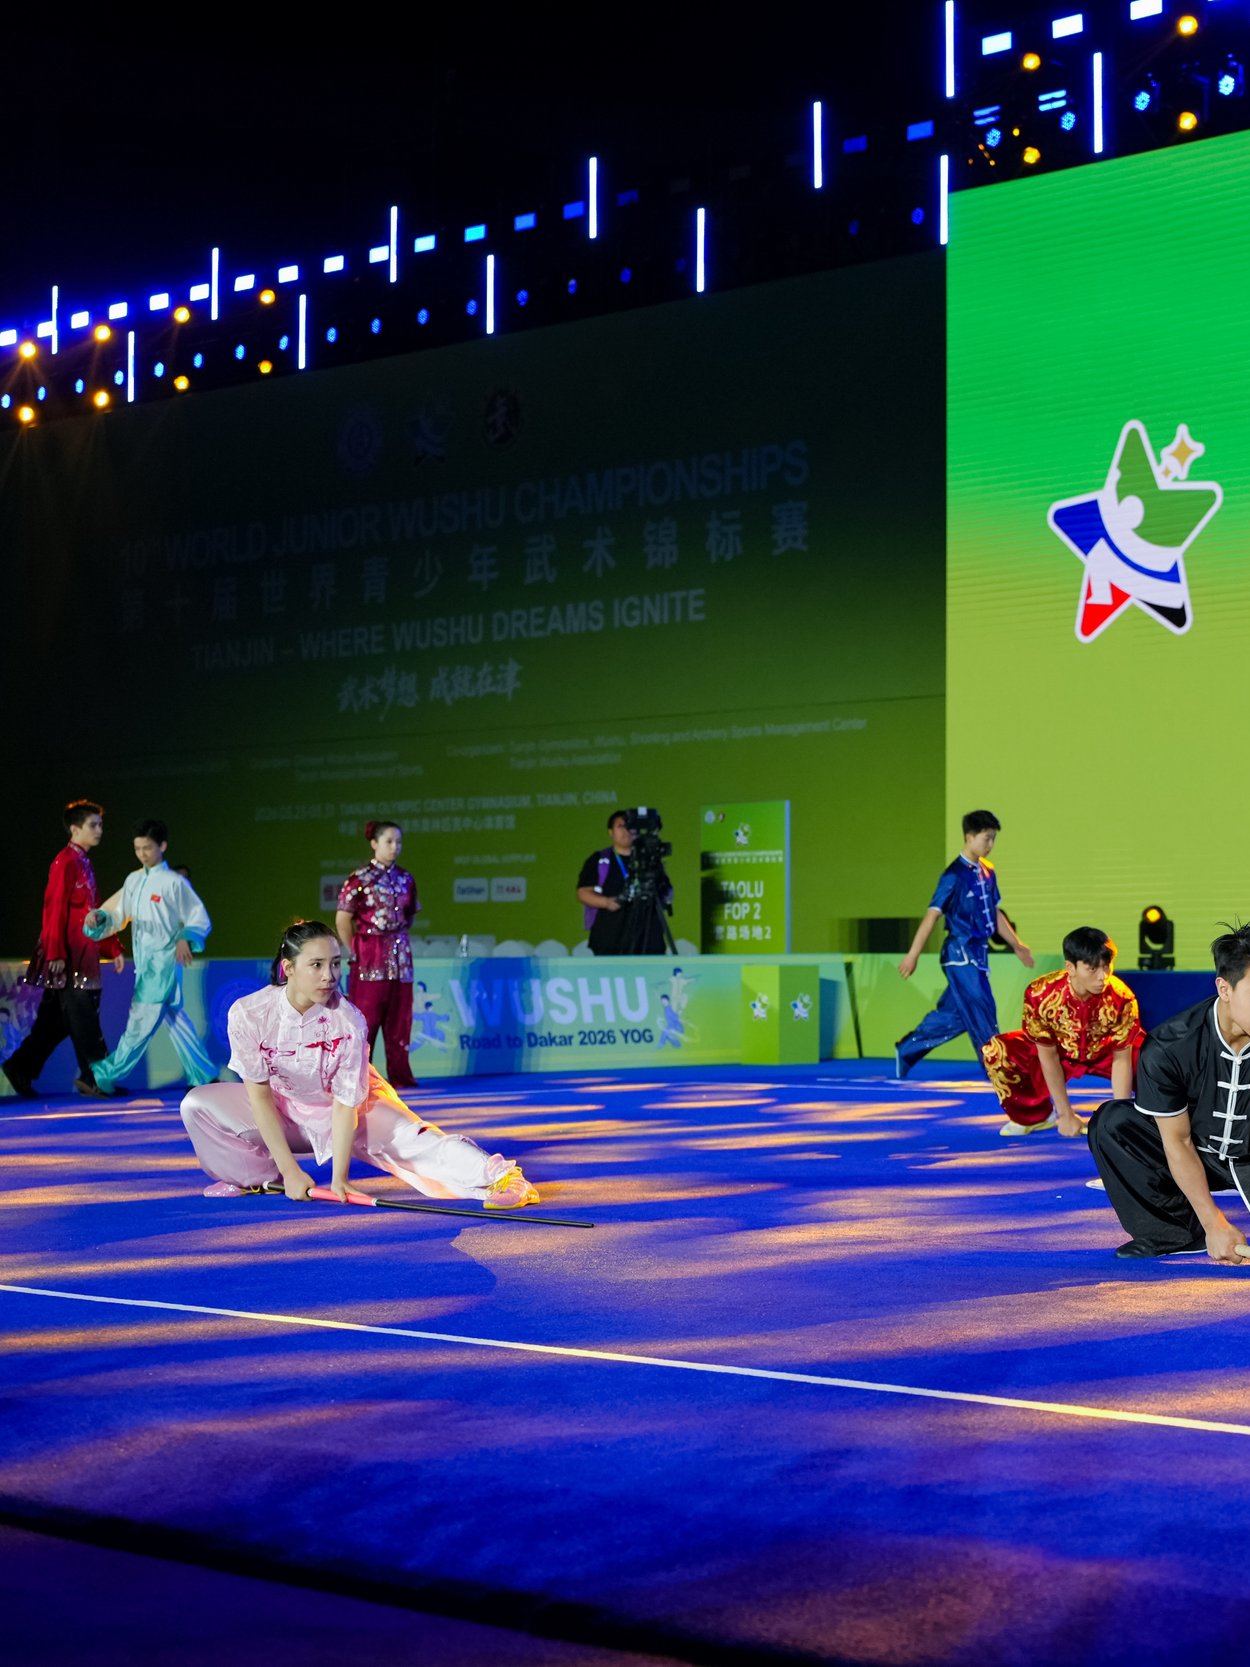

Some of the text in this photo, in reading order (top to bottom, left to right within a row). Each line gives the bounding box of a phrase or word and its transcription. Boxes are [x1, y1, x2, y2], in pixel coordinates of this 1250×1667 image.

[163, 519, 267, 573] WORLD
[274, 503, 383, 555] JUNIOR
[387, 486, 506, 544] WUSHU
[513, 438, 811, 525] CHAMPIONSHIPS
[192, 637, 275, 673] TIANJIN
[299, 624, 386, 662] WHERE
[391, 613, 484, 653] WUSHU
[491, 600, 606, 643] DREAMS
[612, 587, 706, 630] IGNITE
[720, 880, 765, 899] TAOLU
[724, 902, 762, 920] FOP 2
[449, 975, 650, 1028] WUSHU
[459, 1027, 655, 1051] Road to Dakar 2026 YOG
